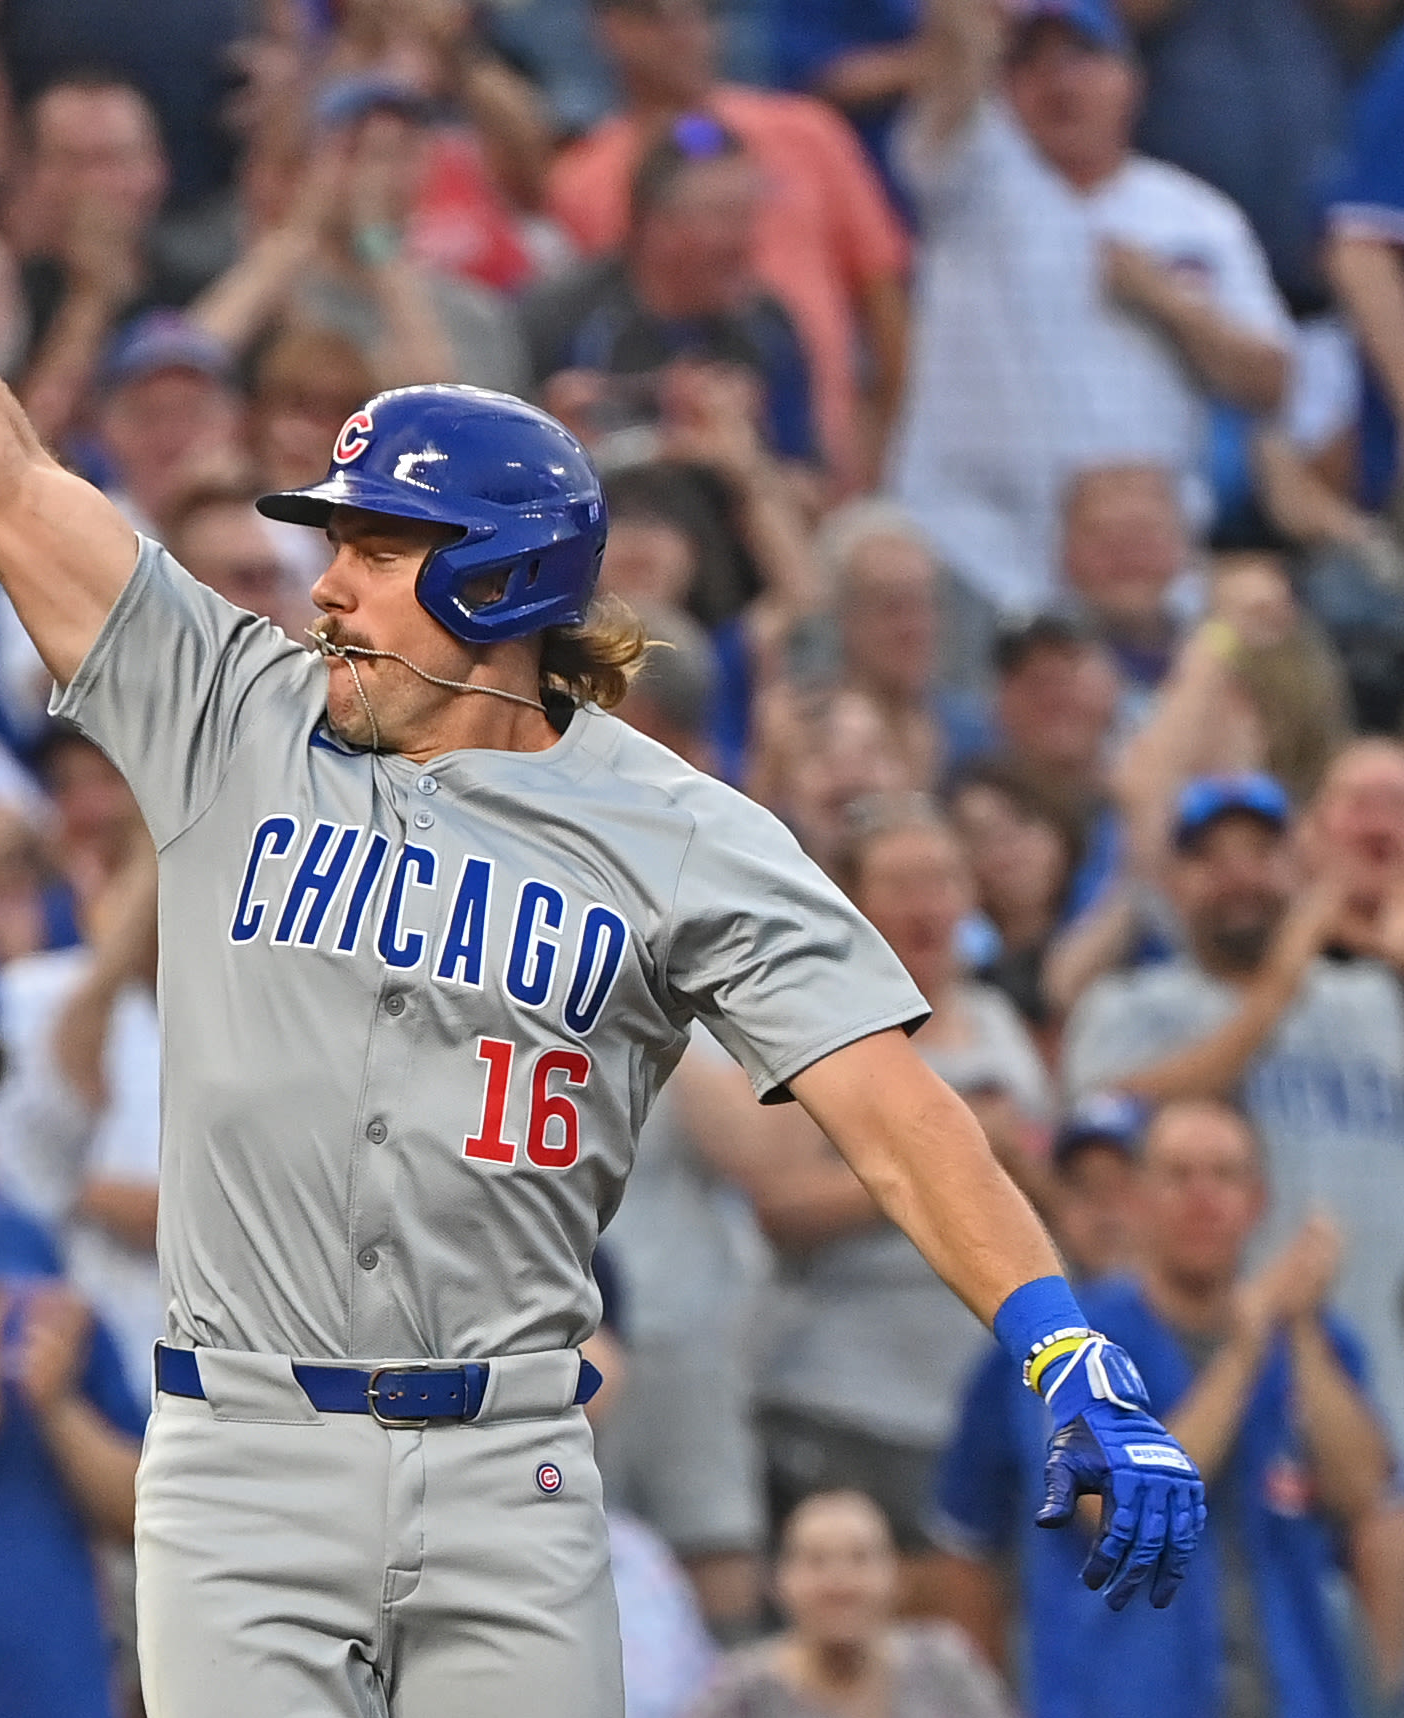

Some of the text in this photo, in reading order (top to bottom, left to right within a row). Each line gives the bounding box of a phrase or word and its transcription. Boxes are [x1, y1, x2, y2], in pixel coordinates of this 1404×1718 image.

[333, 410, 373, 464] C
[227, 813, 631, 1037] CHICAGO
[461, 1036, 591, 1169] 16
